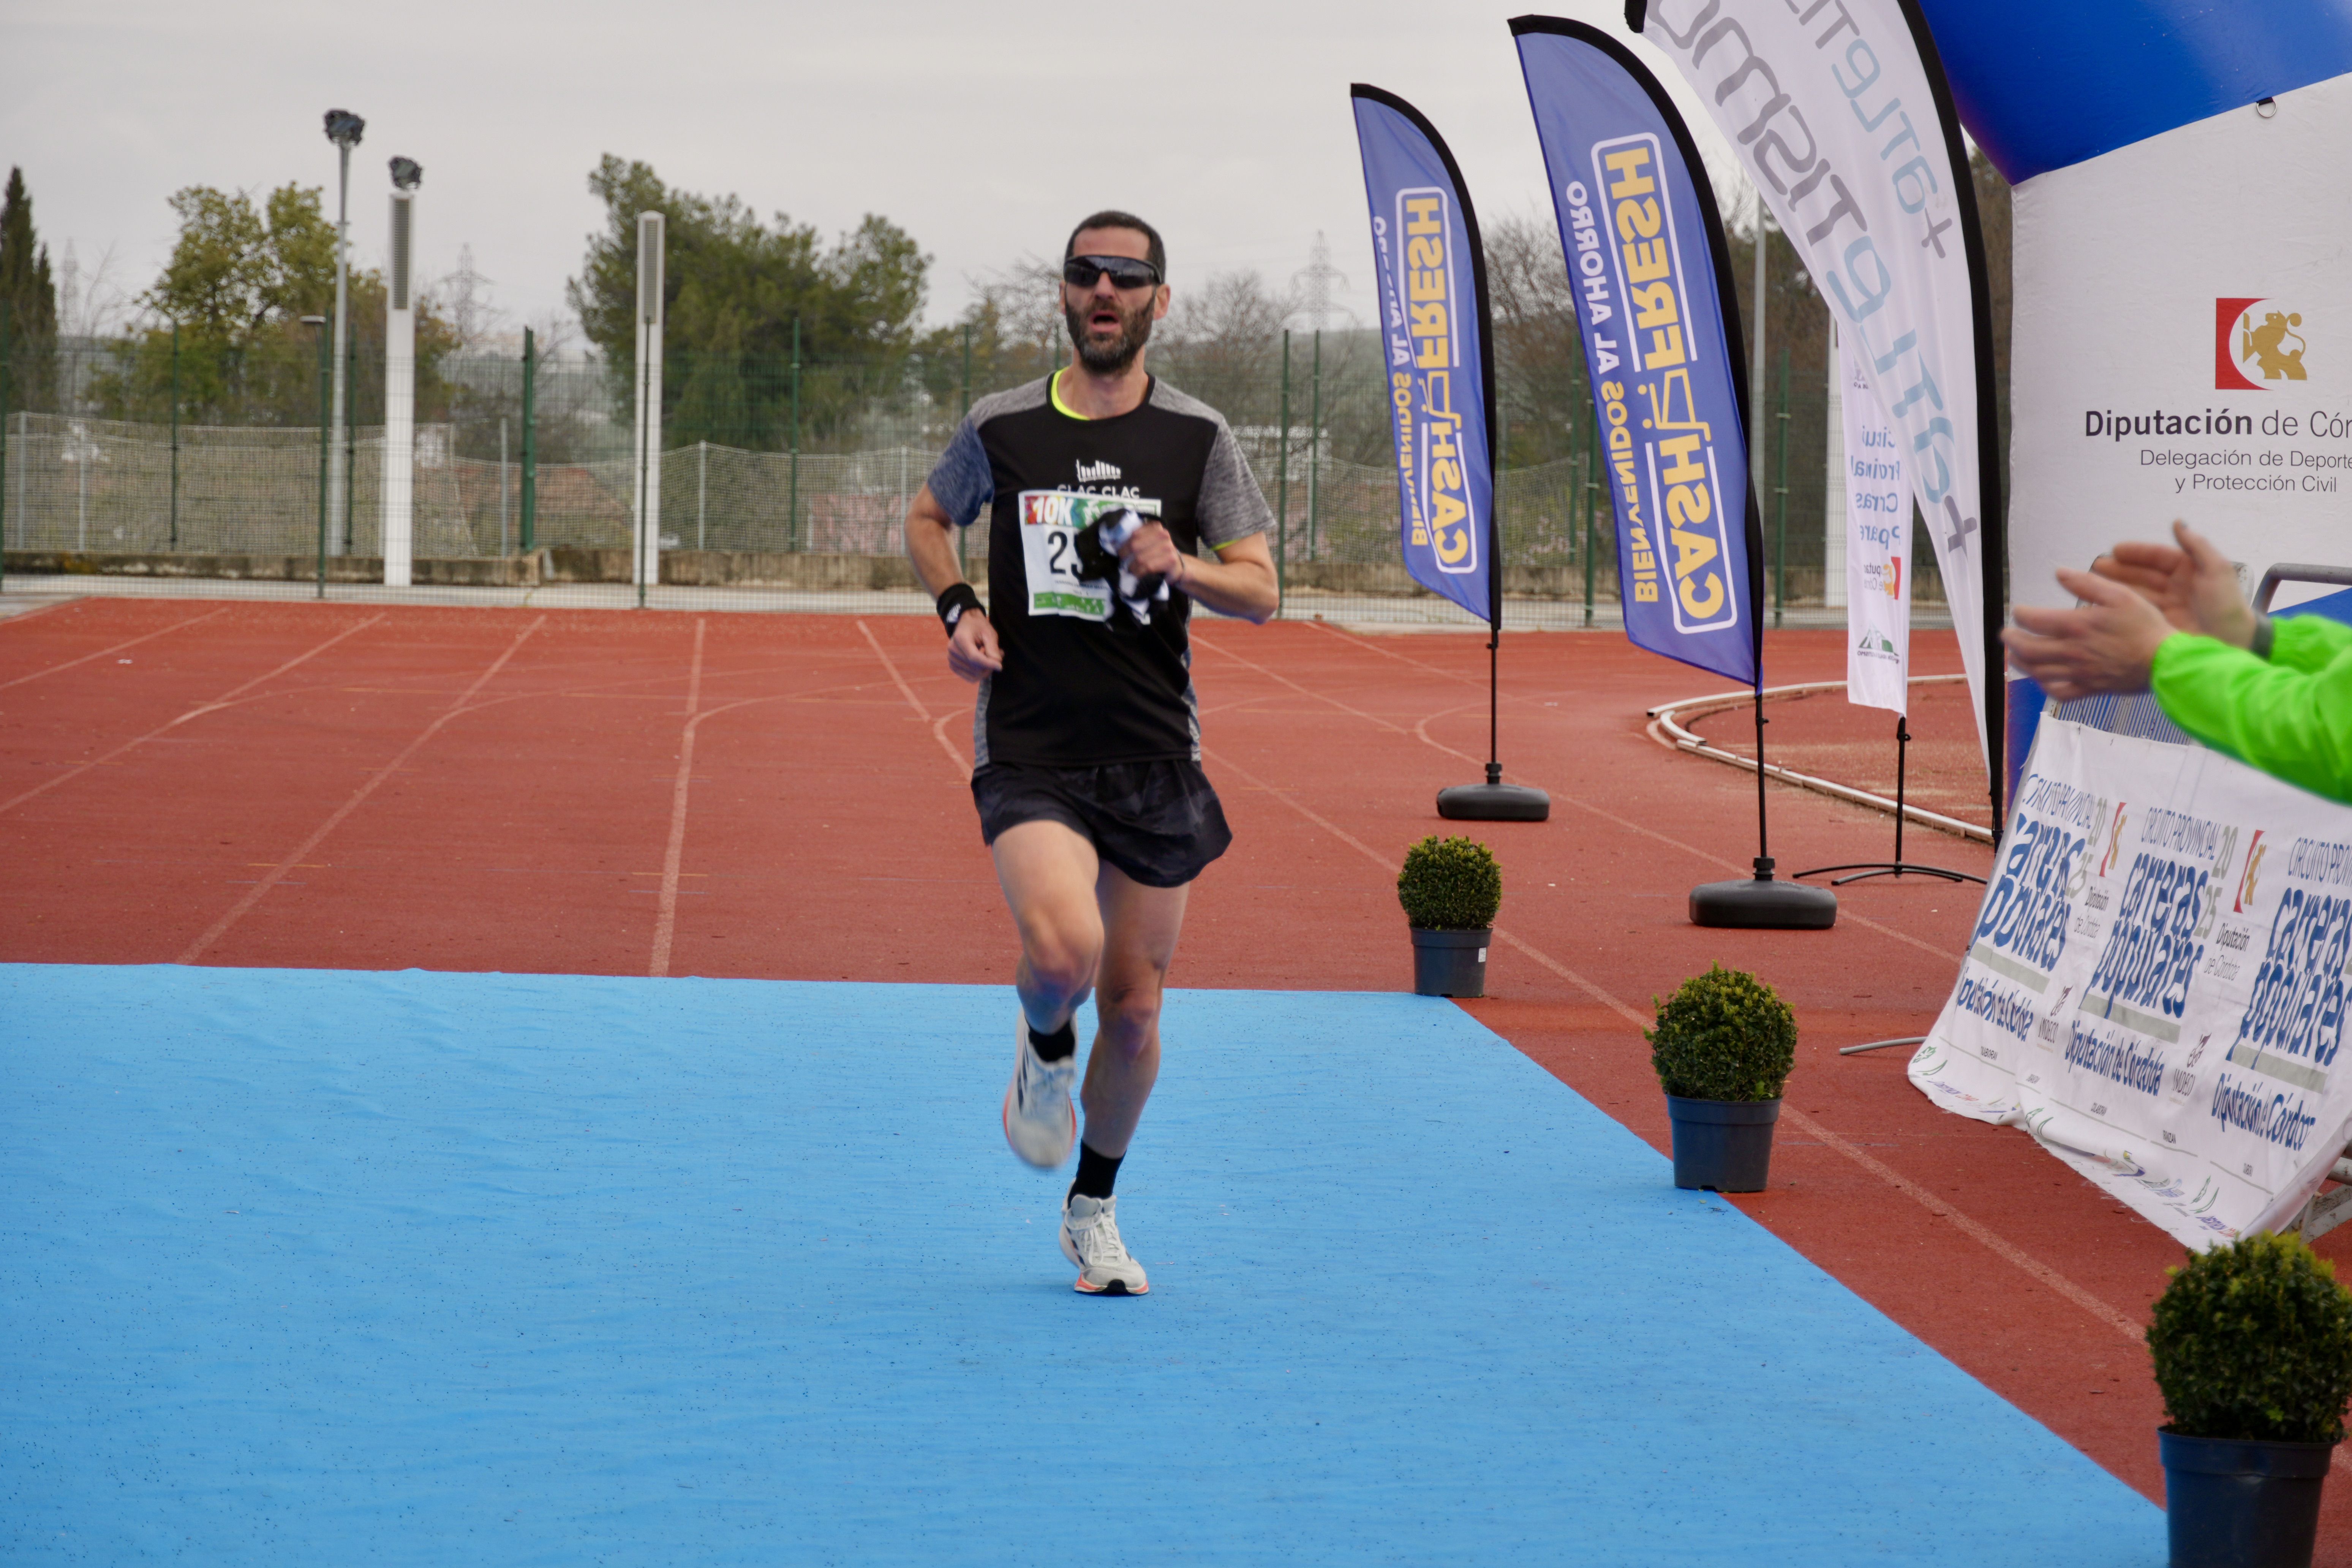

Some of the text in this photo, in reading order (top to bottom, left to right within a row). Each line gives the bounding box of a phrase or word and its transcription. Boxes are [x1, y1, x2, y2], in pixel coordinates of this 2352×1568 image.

[2086, 408, 2252, 442] Diputación
[2262, 410, 2298, 436] de
[2140, 450, 2251, 469] Delegación
[2259, 450, 2283, 466] de
[2175, 474, 2337, 493] y Protección Civil
[1033, 496, 1074, 525] 10K
[2211, 825, 2239, 880] 20
[2288, 837, 2330, 883] CIRCUITO
[2120, 853, 2223, 945] carreras 25
[2216, 922, 2251, 952] Diputación
[2078, 920, 2204, 1020] populares
[2226, 962, 2352, 1070] populares
[2065, 1020, 2165, 1097] Diputación de Córdoba
